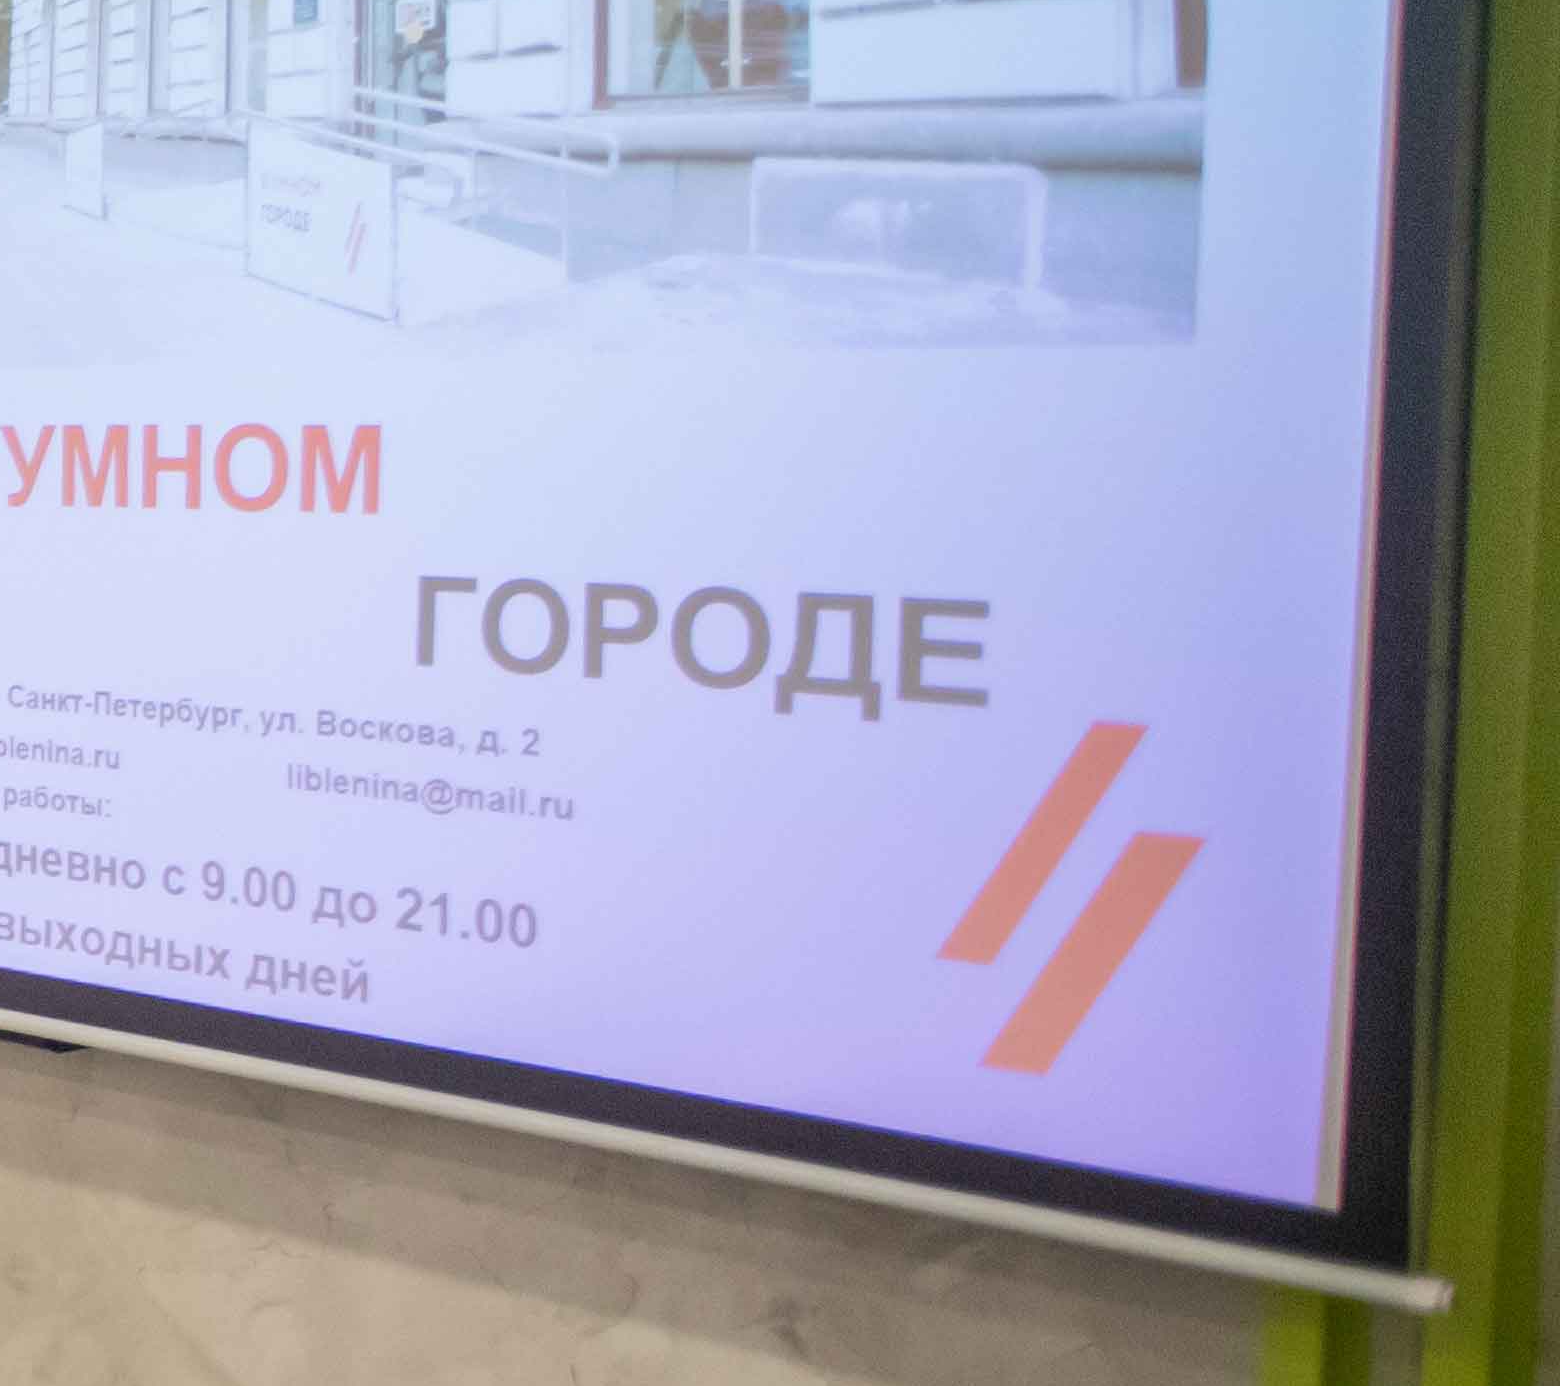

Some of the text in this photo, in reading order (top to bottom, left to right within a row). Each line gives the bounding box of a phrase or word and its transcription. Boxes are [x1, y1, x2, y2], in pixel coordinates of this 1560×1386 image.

[1, 422, 382, 515] УМНОМ
[415, 574, 991, 721] ГОРОДЕ
[7, 685, 250, 733] Санкт-Петербург,
[260, 709, 304, 737] ул.
[316, 711, 465, 754] Воскова,
[476, 731, 508, 757] д.
[521, 728, 541, 757] 2
[4, 786, 113, 818] работы:
[287, 765, 574, 820] liblenina@mail.ru
[162, 862, 185, 897] с
[202, 860, 297, 912] 9.00
[312, 886, 377, 928] до
[396, 888, 538, 948] 21.00
[245, 953, 371, 1003] дней
